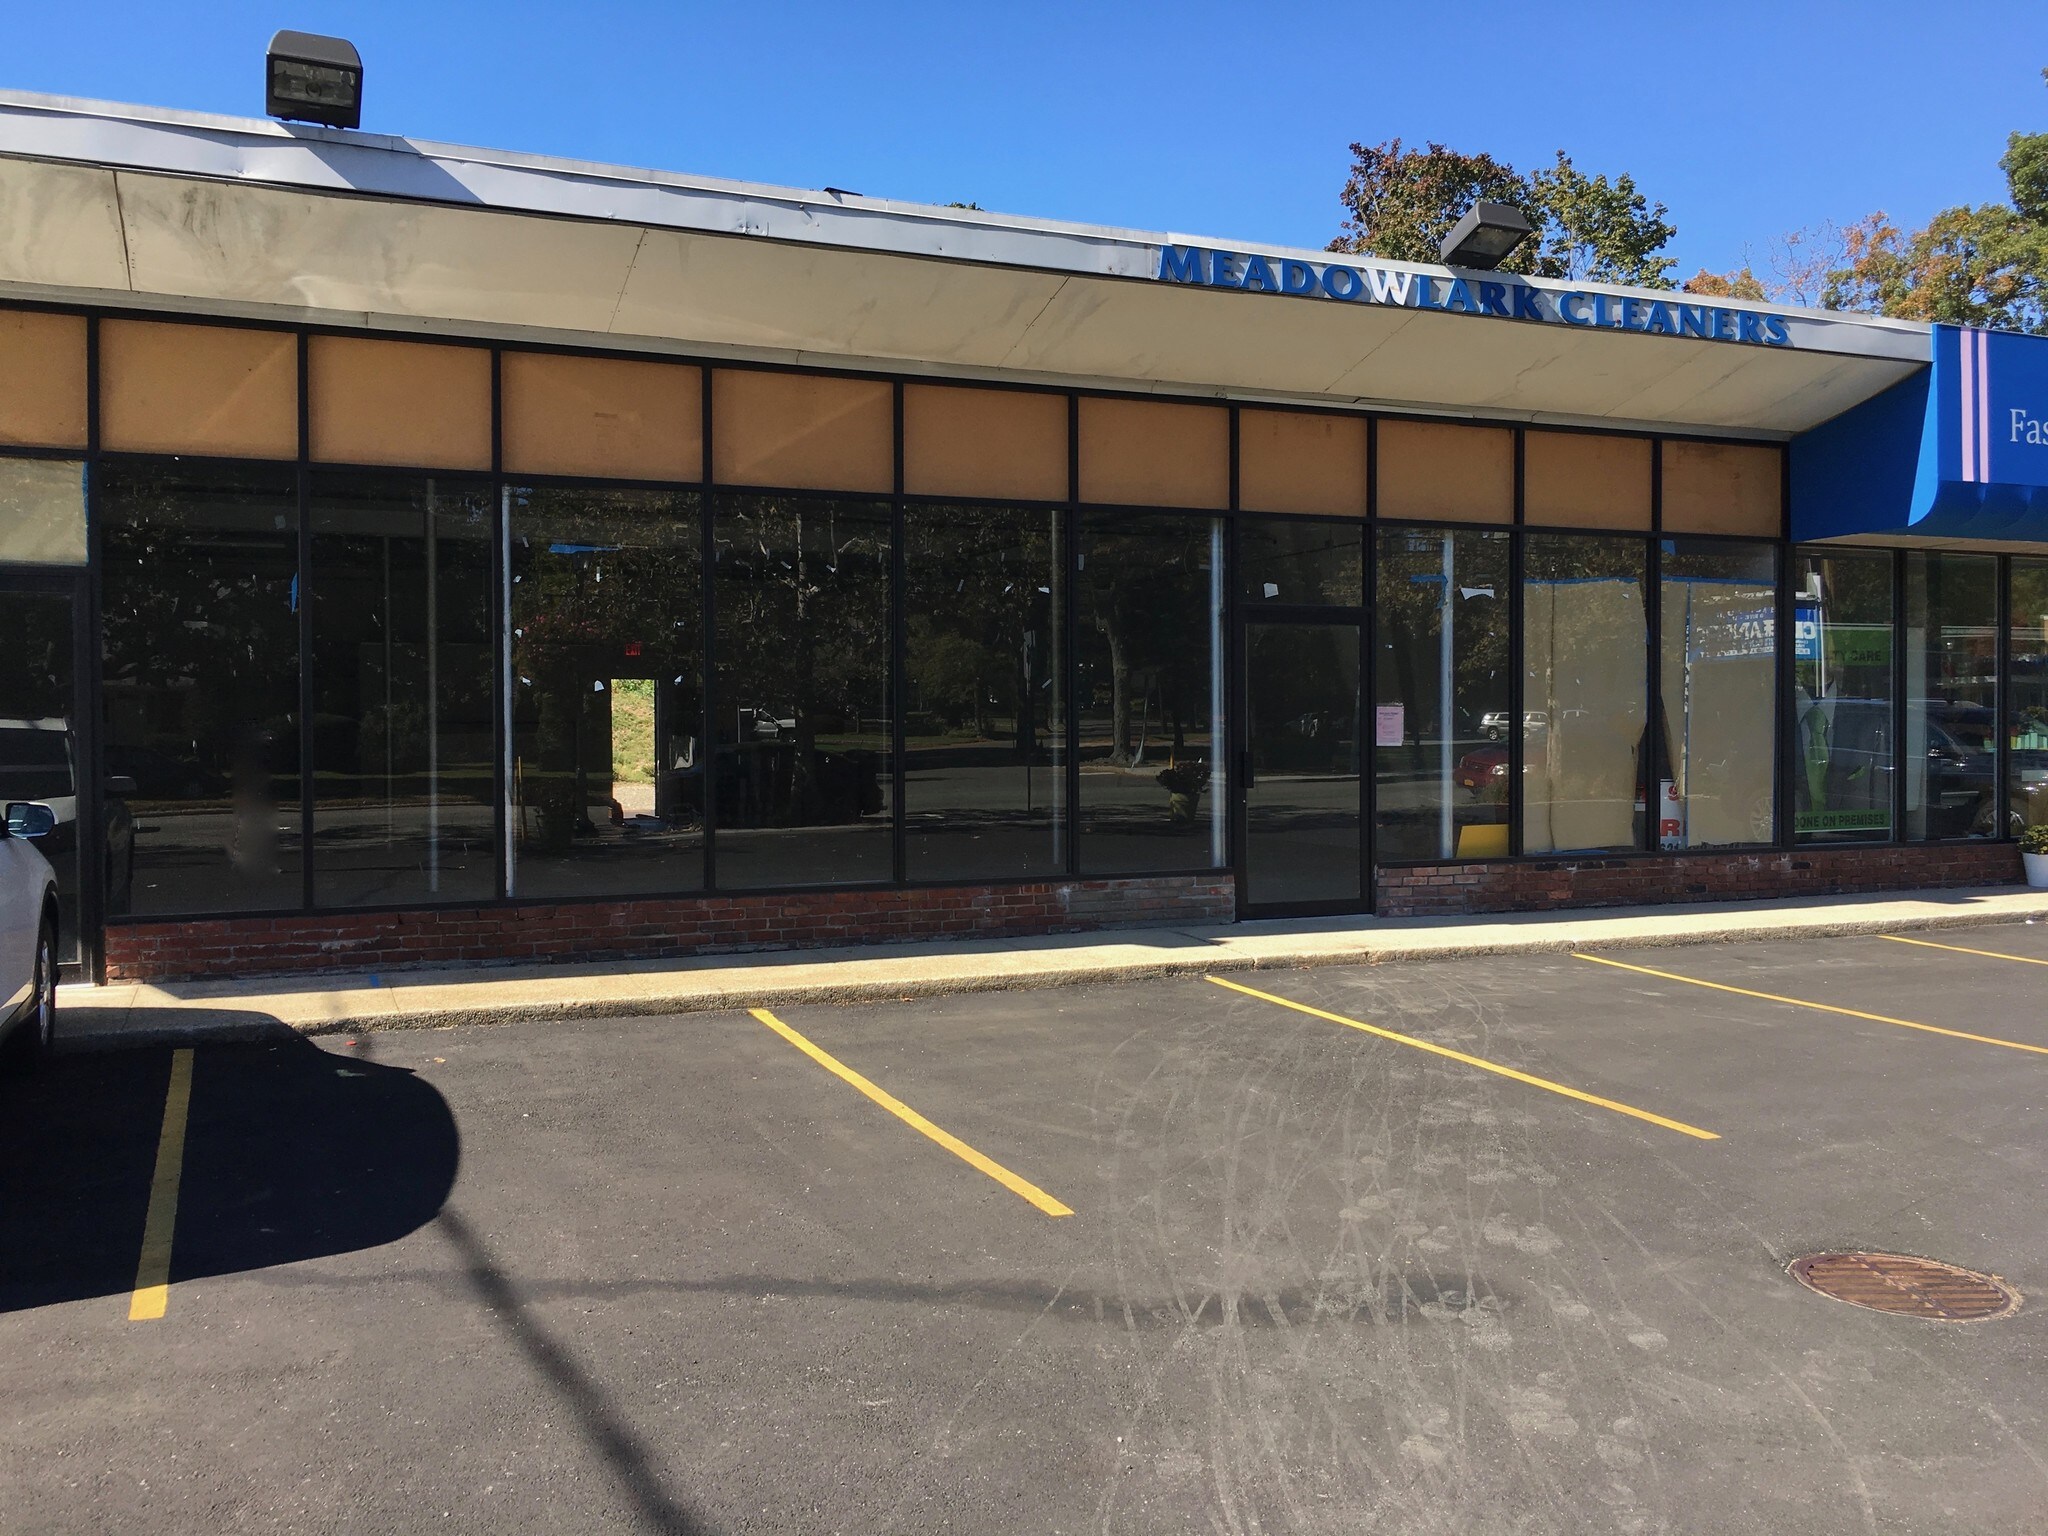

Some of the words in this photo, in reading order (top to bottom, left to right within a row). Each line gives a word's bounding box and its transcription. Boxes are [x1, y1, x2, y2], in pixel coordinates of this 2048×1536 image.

[1158, 245, 1544, 320] MEADOWLARK
[1558, 290, 1790, 346] CLEANERS
[1852, 650, 1881, 661] CARE
[1822, 815, 1836, 827] ON
[1839, 813, 1885, 826] PREMISES
